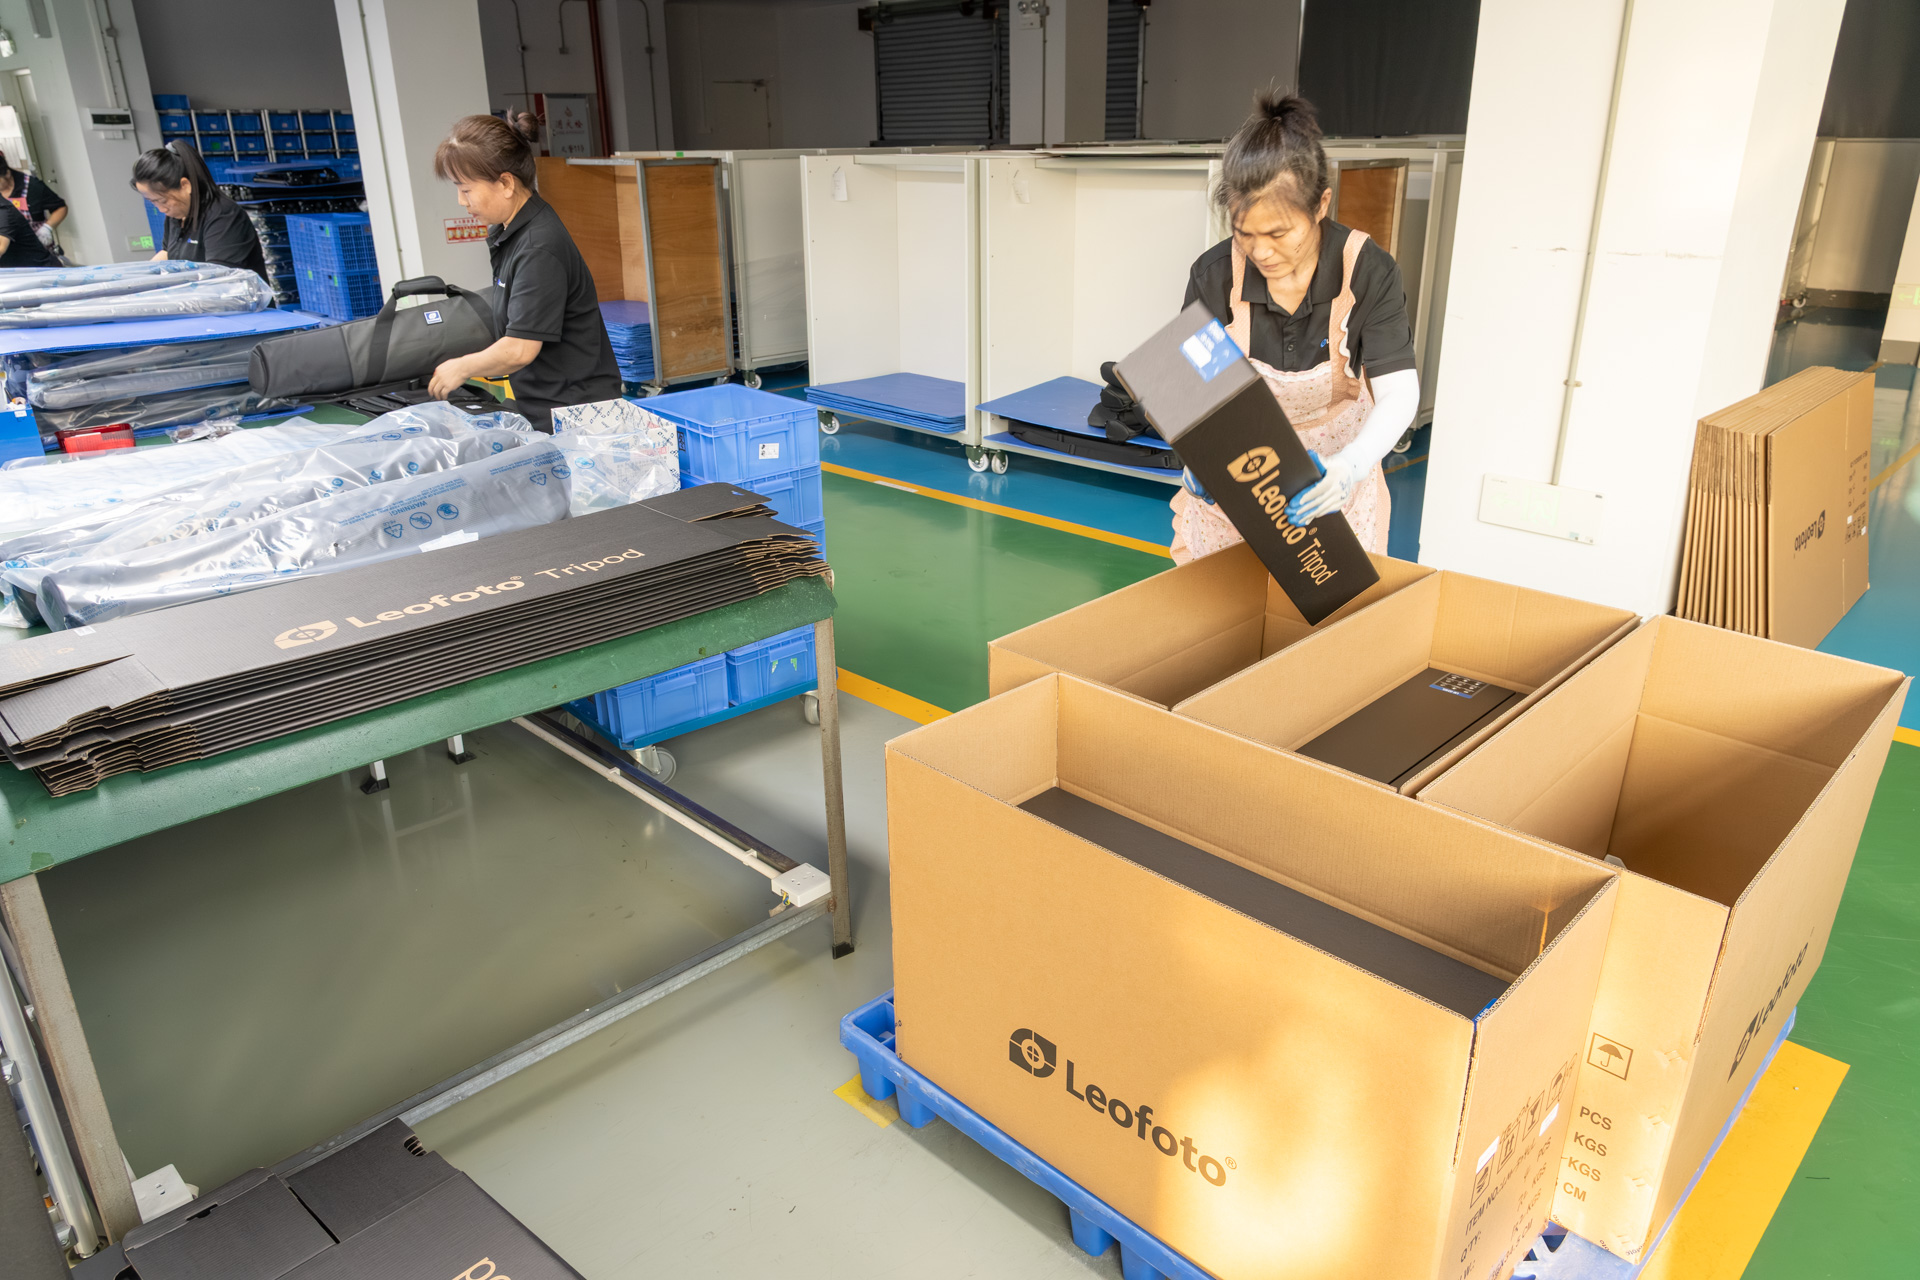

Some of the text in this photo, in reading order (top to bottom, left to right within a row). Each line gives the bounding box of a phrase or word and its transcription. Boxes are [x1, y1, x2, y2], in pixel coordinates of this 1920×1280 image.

[389, 500, 428, 517] WARNING!
[1794, 519, 1818, 552] Leofoto
[534, 548, 645, 581] Tripod
[1297, 537, 1338, 586] Tripod
[1753, 942, 1809, 1039] Leofoto
[1579, 1105, 1612, 1131] PCS
[1573, 1131, 1607, 1157] KGS
[1567, 1156, 1601, 1182] KGS
[1563, 1182, 1587, 1202] CM
[1465, 1202, 1486, 1236] ITEM
